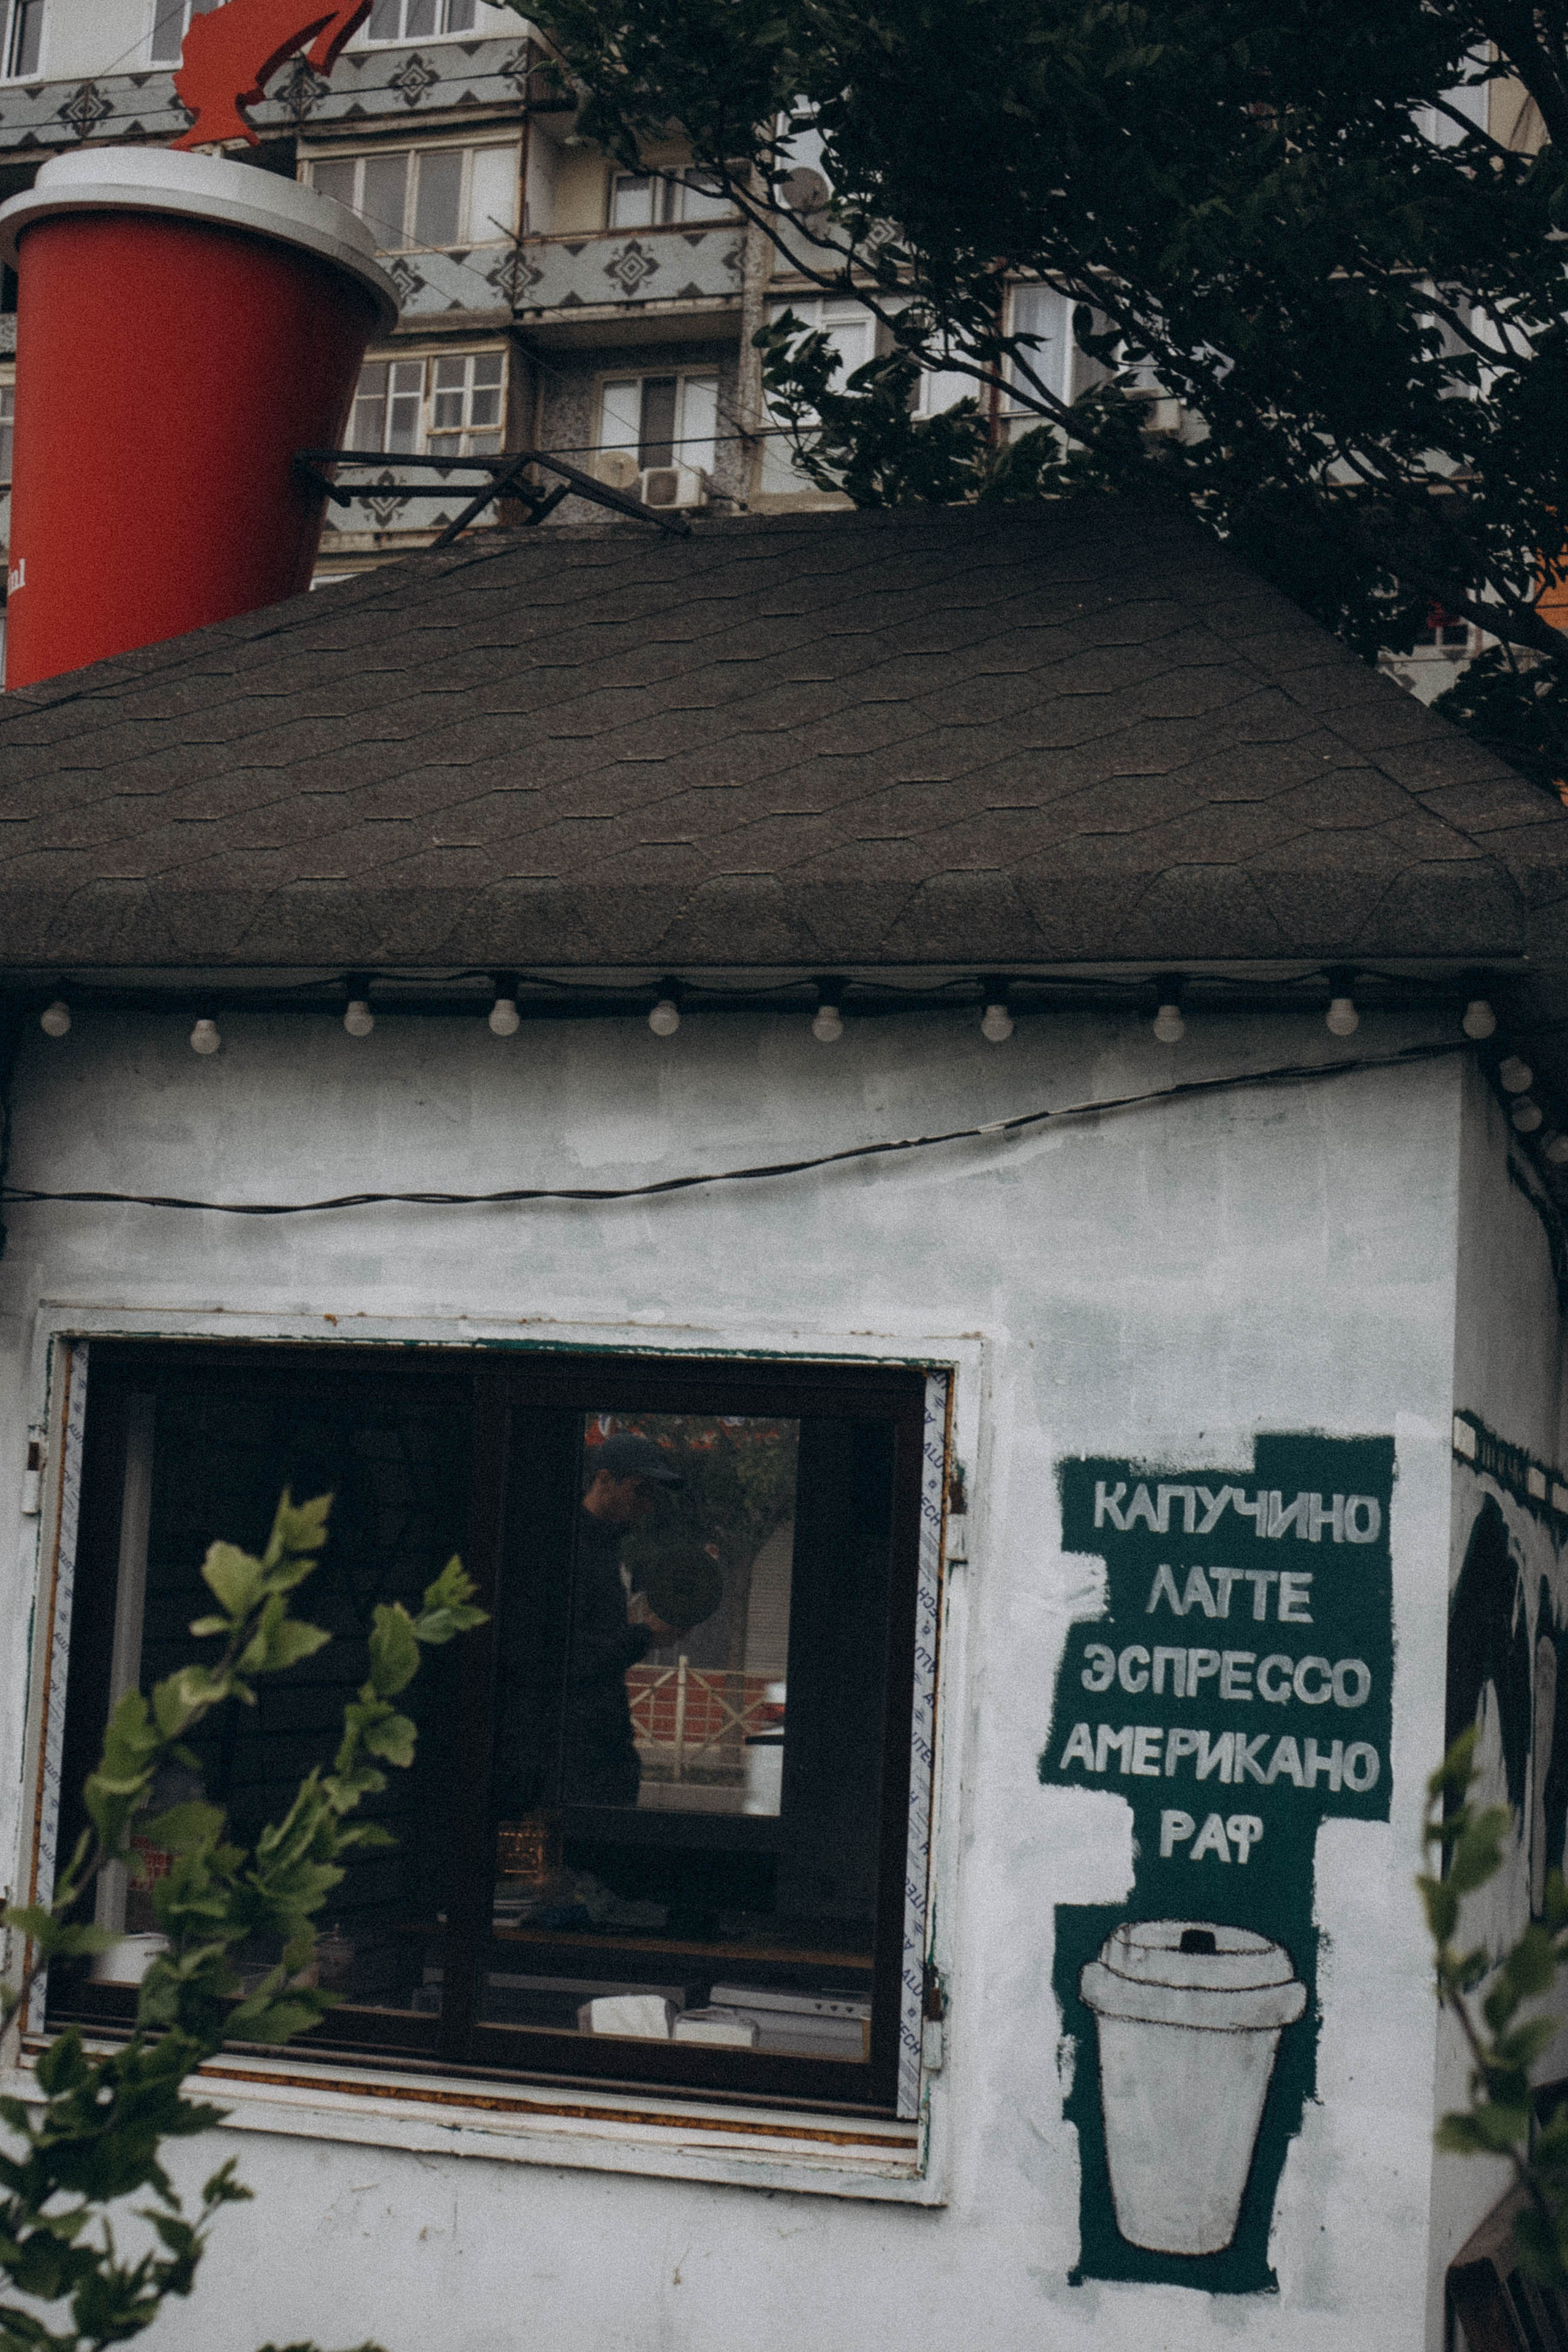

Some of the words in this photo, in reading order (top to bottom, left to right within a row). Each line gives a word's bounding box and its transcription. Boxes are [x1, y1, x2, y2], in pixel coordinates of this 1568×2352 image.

[1094, 1481, 1381, 1543] КАПУЧИНО
[1146, 1564, 1314, 1623] ЛАТТЕ
[1080, 1644, 1371, 1708] ЭСПРЕССО
[1060, 1723, 1380, 1792] АМЕРИКАНО
[1160, 1809, 1264, 1864] РАФ
